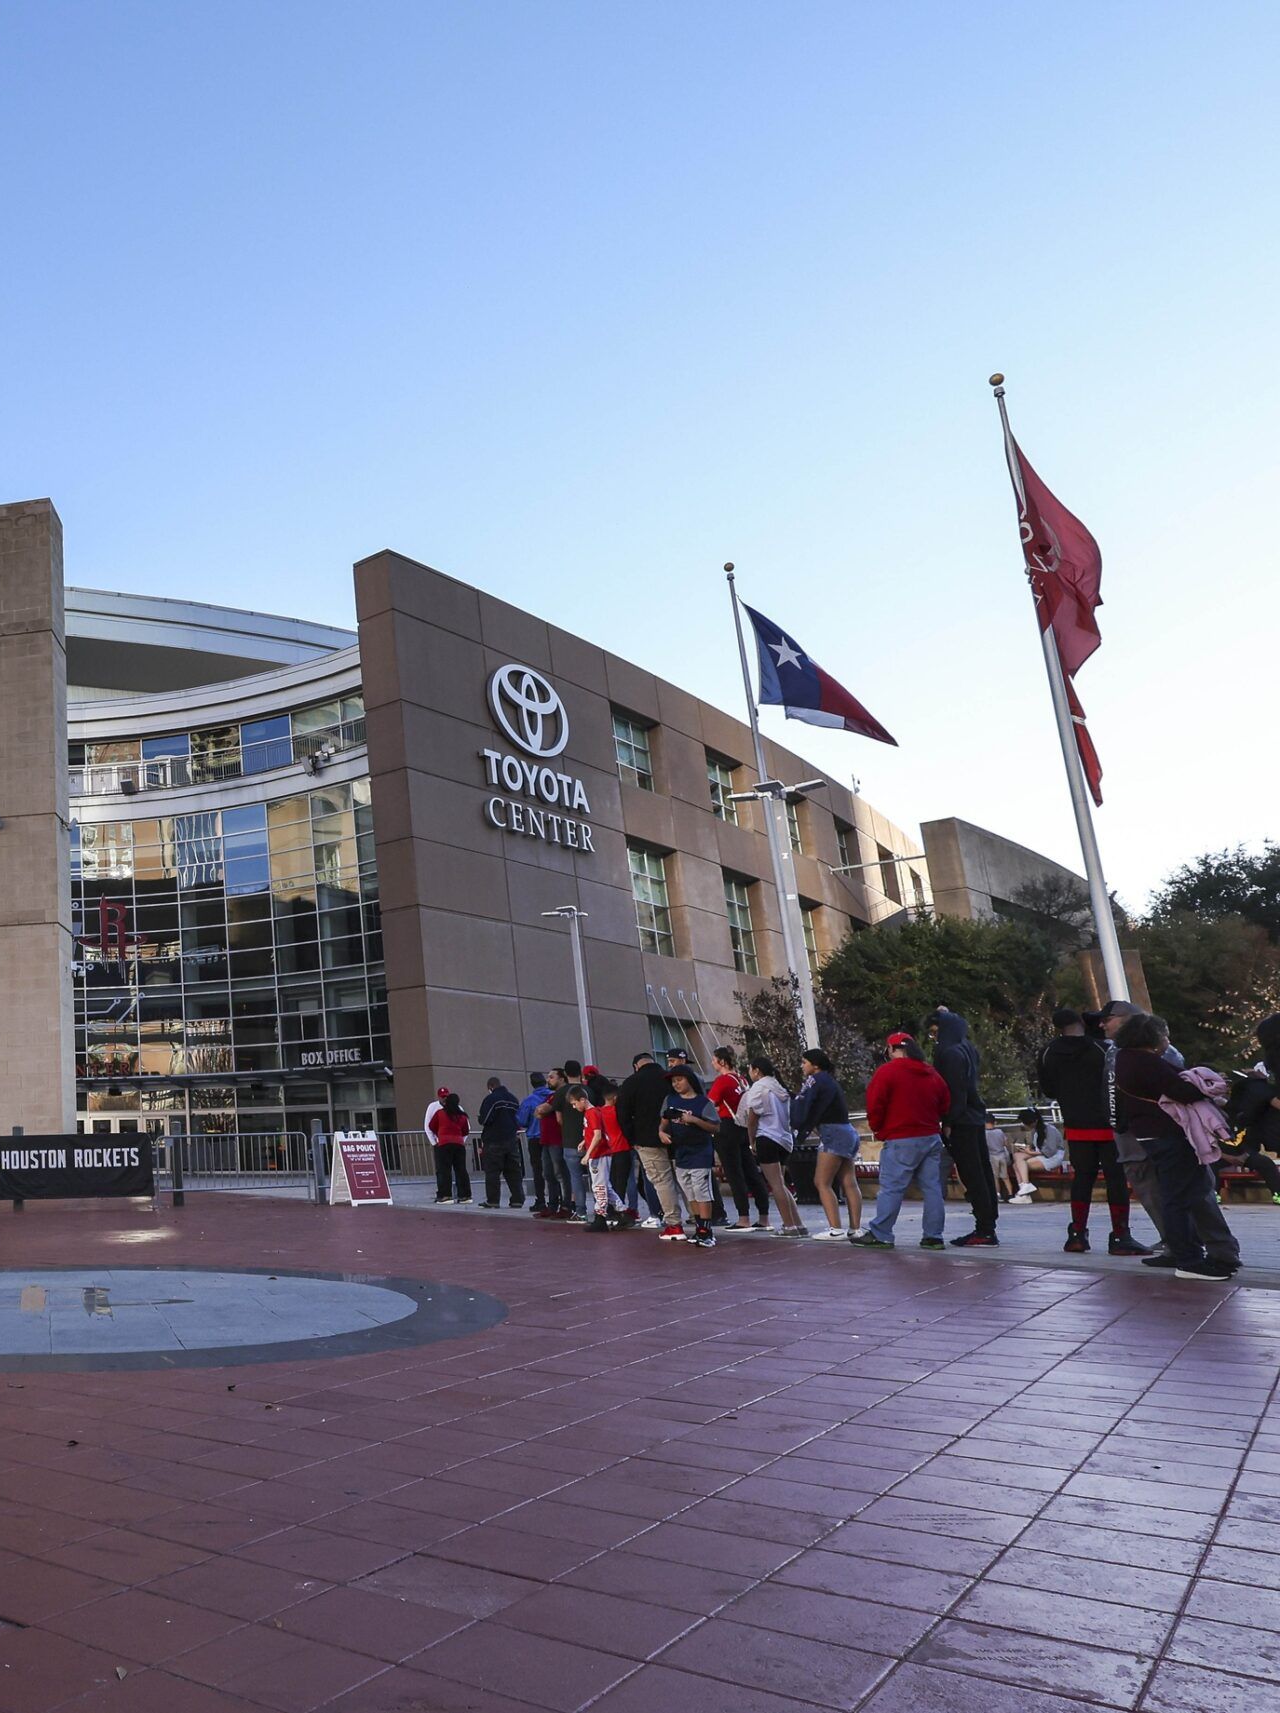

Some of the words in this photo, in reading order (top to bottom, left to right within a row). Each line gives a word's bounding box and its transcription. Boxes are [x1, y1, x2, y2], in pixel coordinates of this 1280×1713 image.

[480, 748, 591, 814] TOYOTA
[486, 797, 596, 852] CENTER
[301, 1051, 324, 1065] BOX
[326, 1048, 361, 1065] OFFICE
[1, 1149, 67, 1170] HOUSTON
[74, 1147, 140, 1169] ROCKETS
[342, 1144, 355, 1153] BAG
[356, 1144, 376, 1152] POLICY
